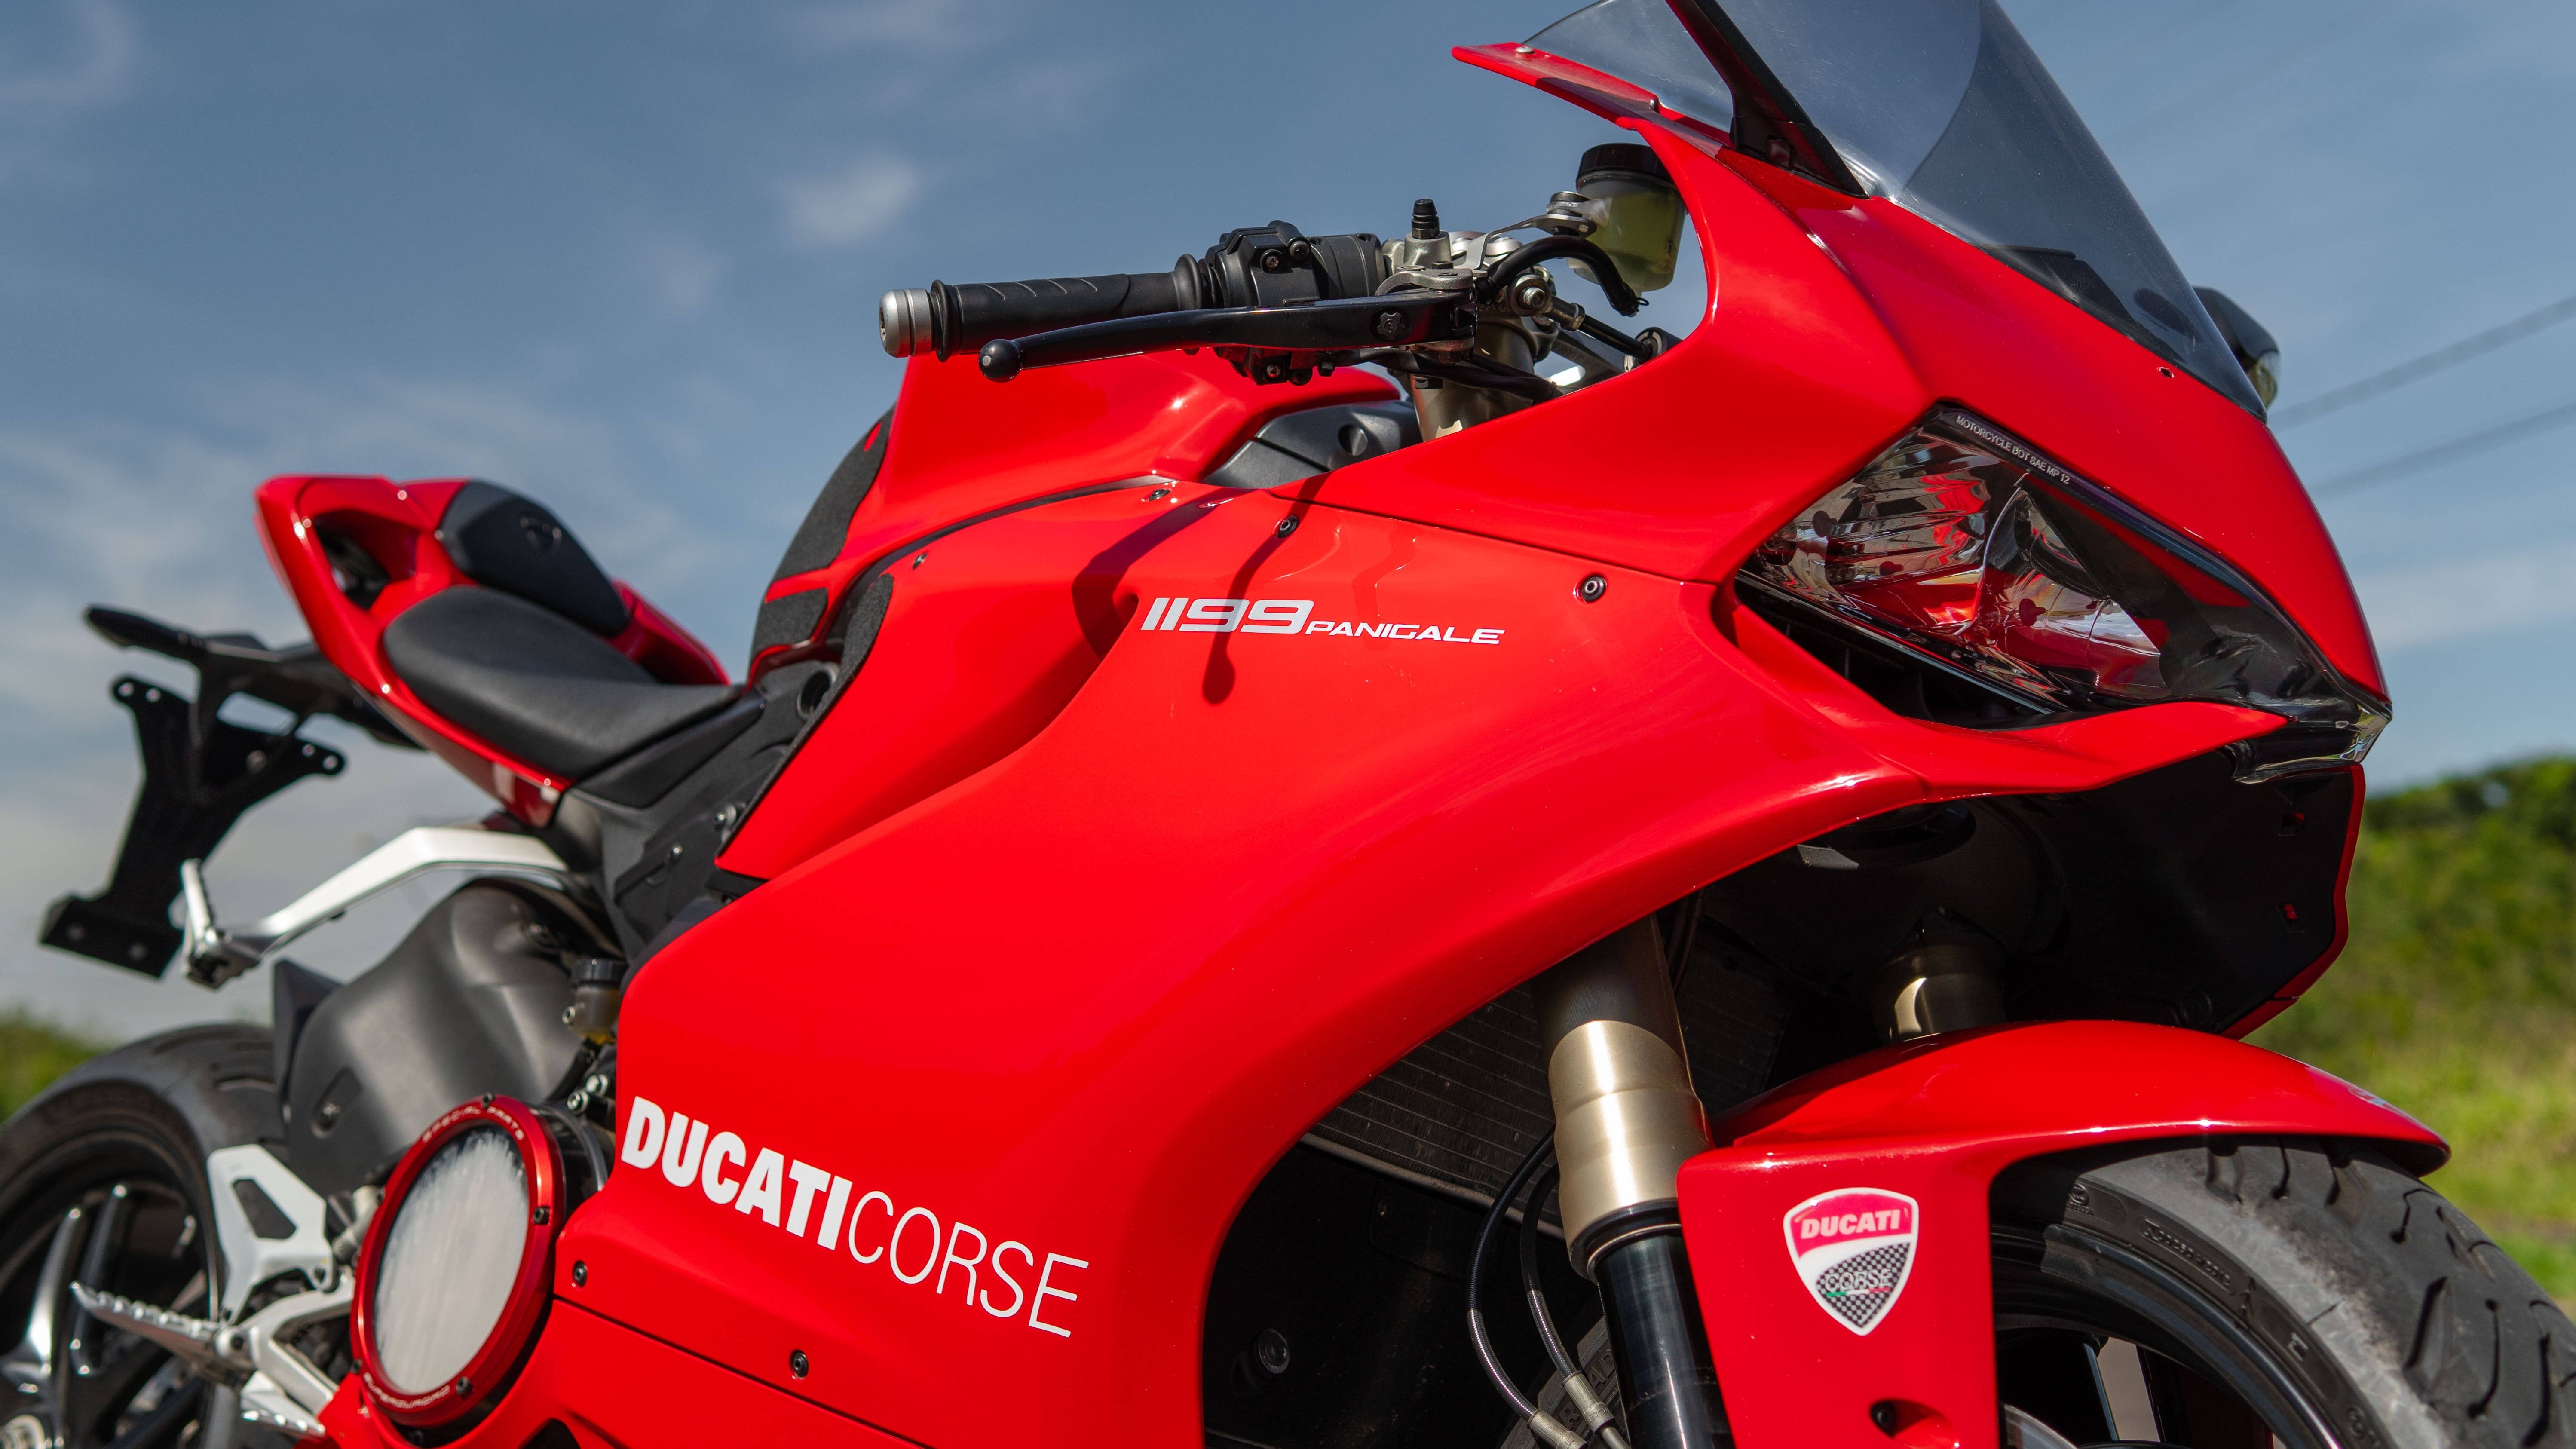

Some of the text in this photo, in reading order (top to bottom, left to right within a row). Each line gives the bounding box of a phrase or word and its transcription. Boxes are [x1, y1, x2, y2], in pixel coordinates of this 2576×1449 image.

[1957, 415, 2070, 484] MOTORCYCLE DOT SAE MP 12
[1141, 597, 1505, 644] 1199 PANIGALE
[422, 1106, 524, 1143] SPECIAL PARTS
[621, 1096, 1089, 1337] DUCATI CORSE
[1801, 1209, 1900, 1239] DUCATI
[1825, 1268, 1892, 1292] CORSE
[1559, 1348, 1615, 1431] RAD
